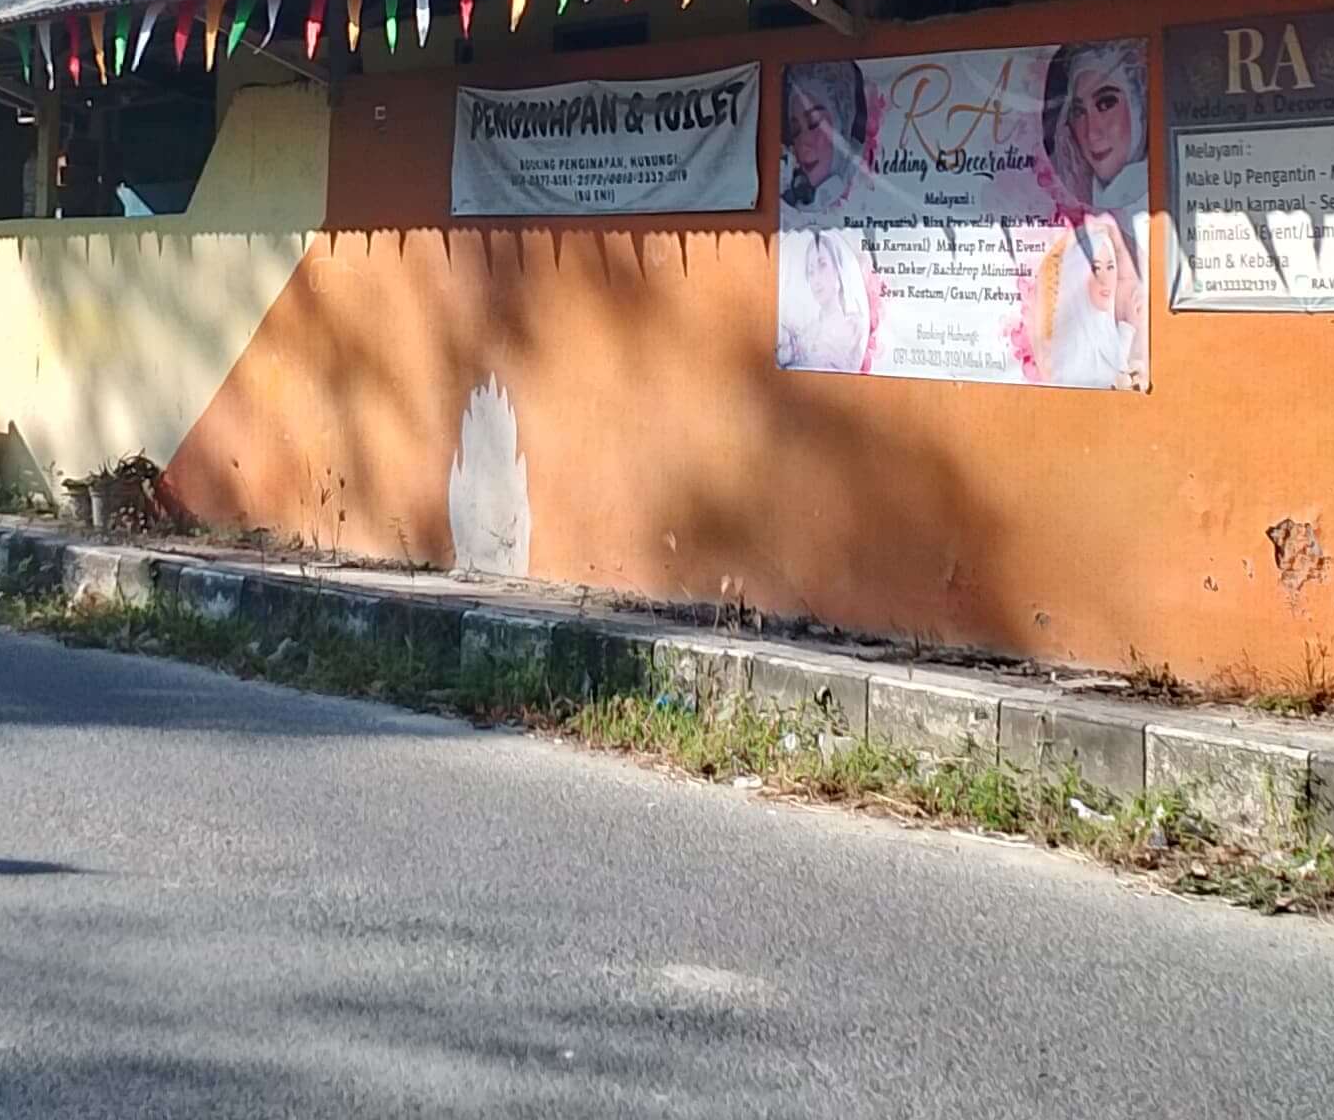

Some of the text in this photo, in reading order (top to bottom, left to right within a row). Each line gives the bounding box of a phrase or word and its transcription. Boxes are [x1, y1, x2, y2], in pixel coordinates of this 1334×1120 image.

[1223, 24, 1315, 94] RA
[470, 81, 745, 140] PENGINAPAN & TOILET
[1174, 99, 1247, 120] Wedding
[1185, 139, 1244, 161] Melayani
[869, 148, 928, 181] Wedding
[1187, 170, 1219, 186] Make
[1224, 170, 1242, 188] Up
[1246, 165, 1315, 188] Pengantin
[1187, 196, 1219, 214] Make
[1247, 194, 1305, 212] karnaval
[1187, 224, 1250, 241] Minimalis
[978, 240, 995, 252] For
[1188, 255, 1221, 270] Gaun
[1225, 253, 1235, 269] &
[879, 282, 905, 298] Sewa
